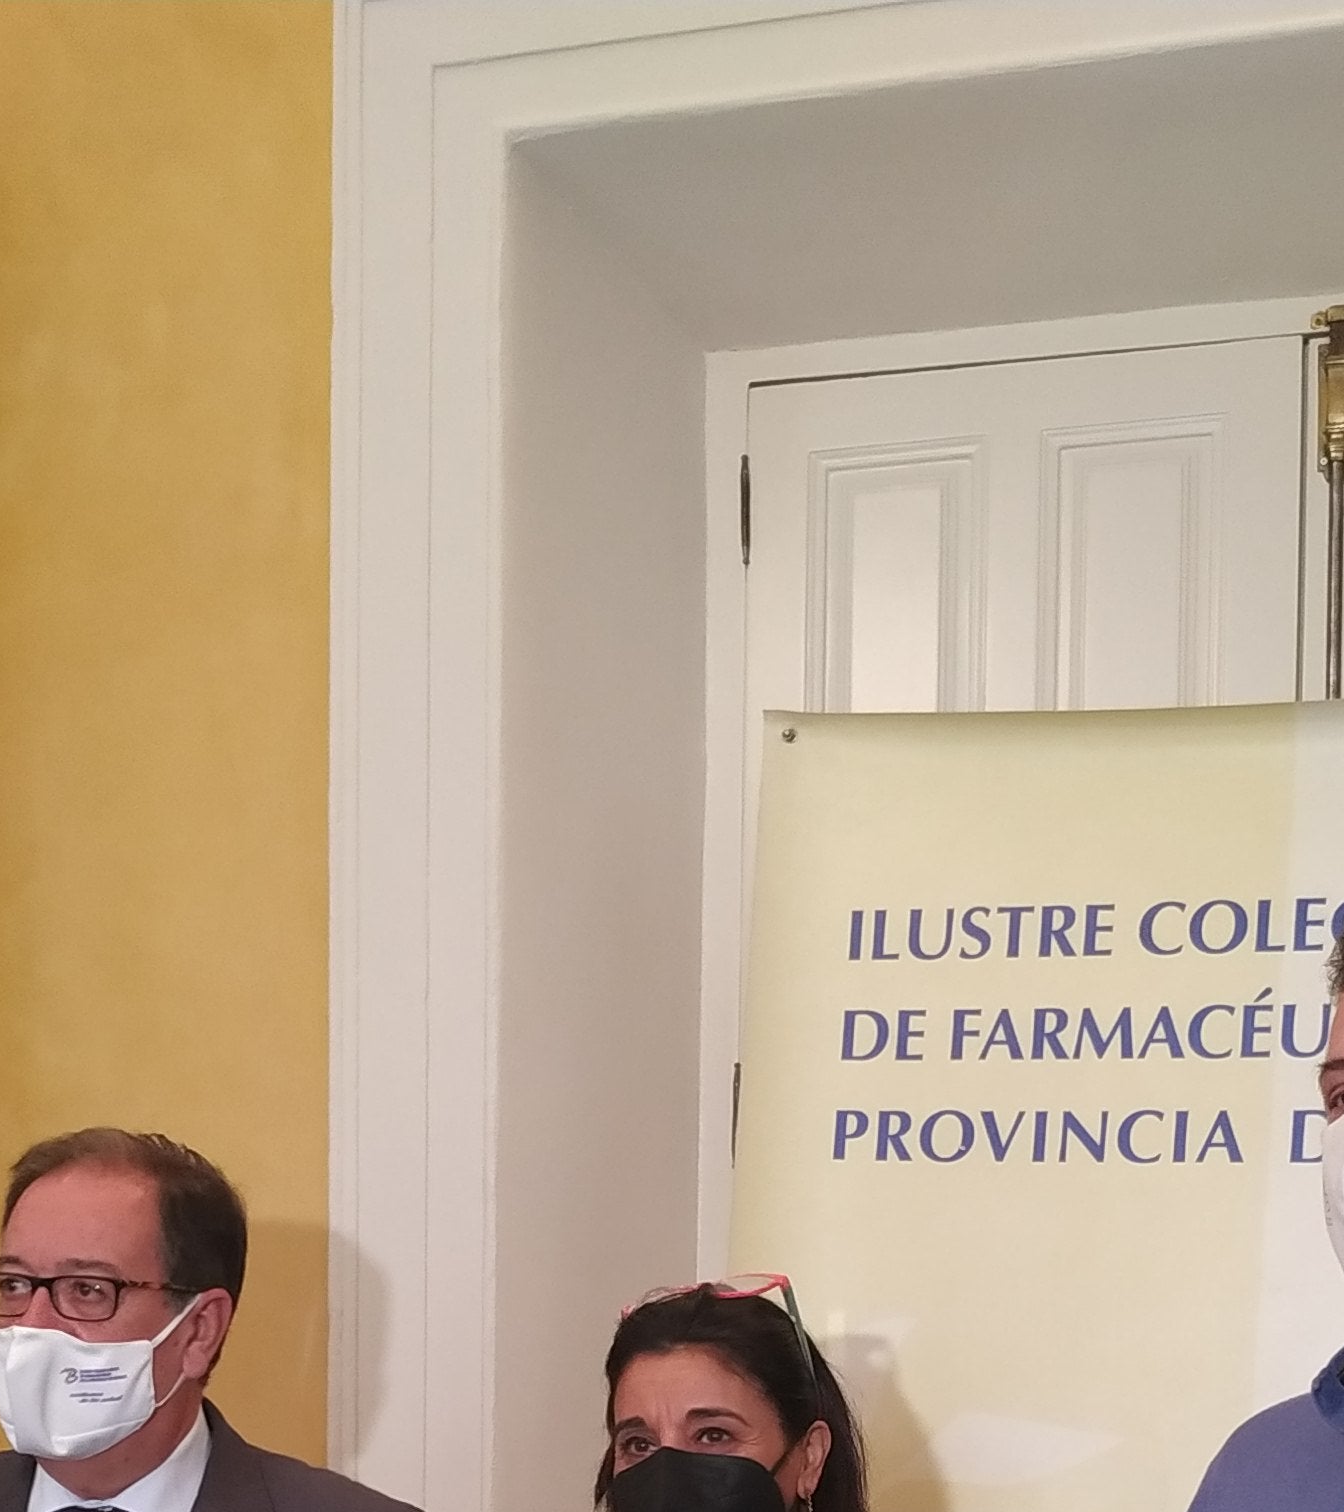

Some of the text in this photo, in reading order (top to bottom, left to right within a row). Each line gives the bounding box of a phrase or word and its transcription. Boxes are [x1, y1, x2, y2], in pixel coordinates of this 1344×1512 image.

[848, 904, 1115, 961] ILUSTRE
[841, 1009, 926, 1061] DE
[832, 1109, 1244, 1164] PROVINCIA
